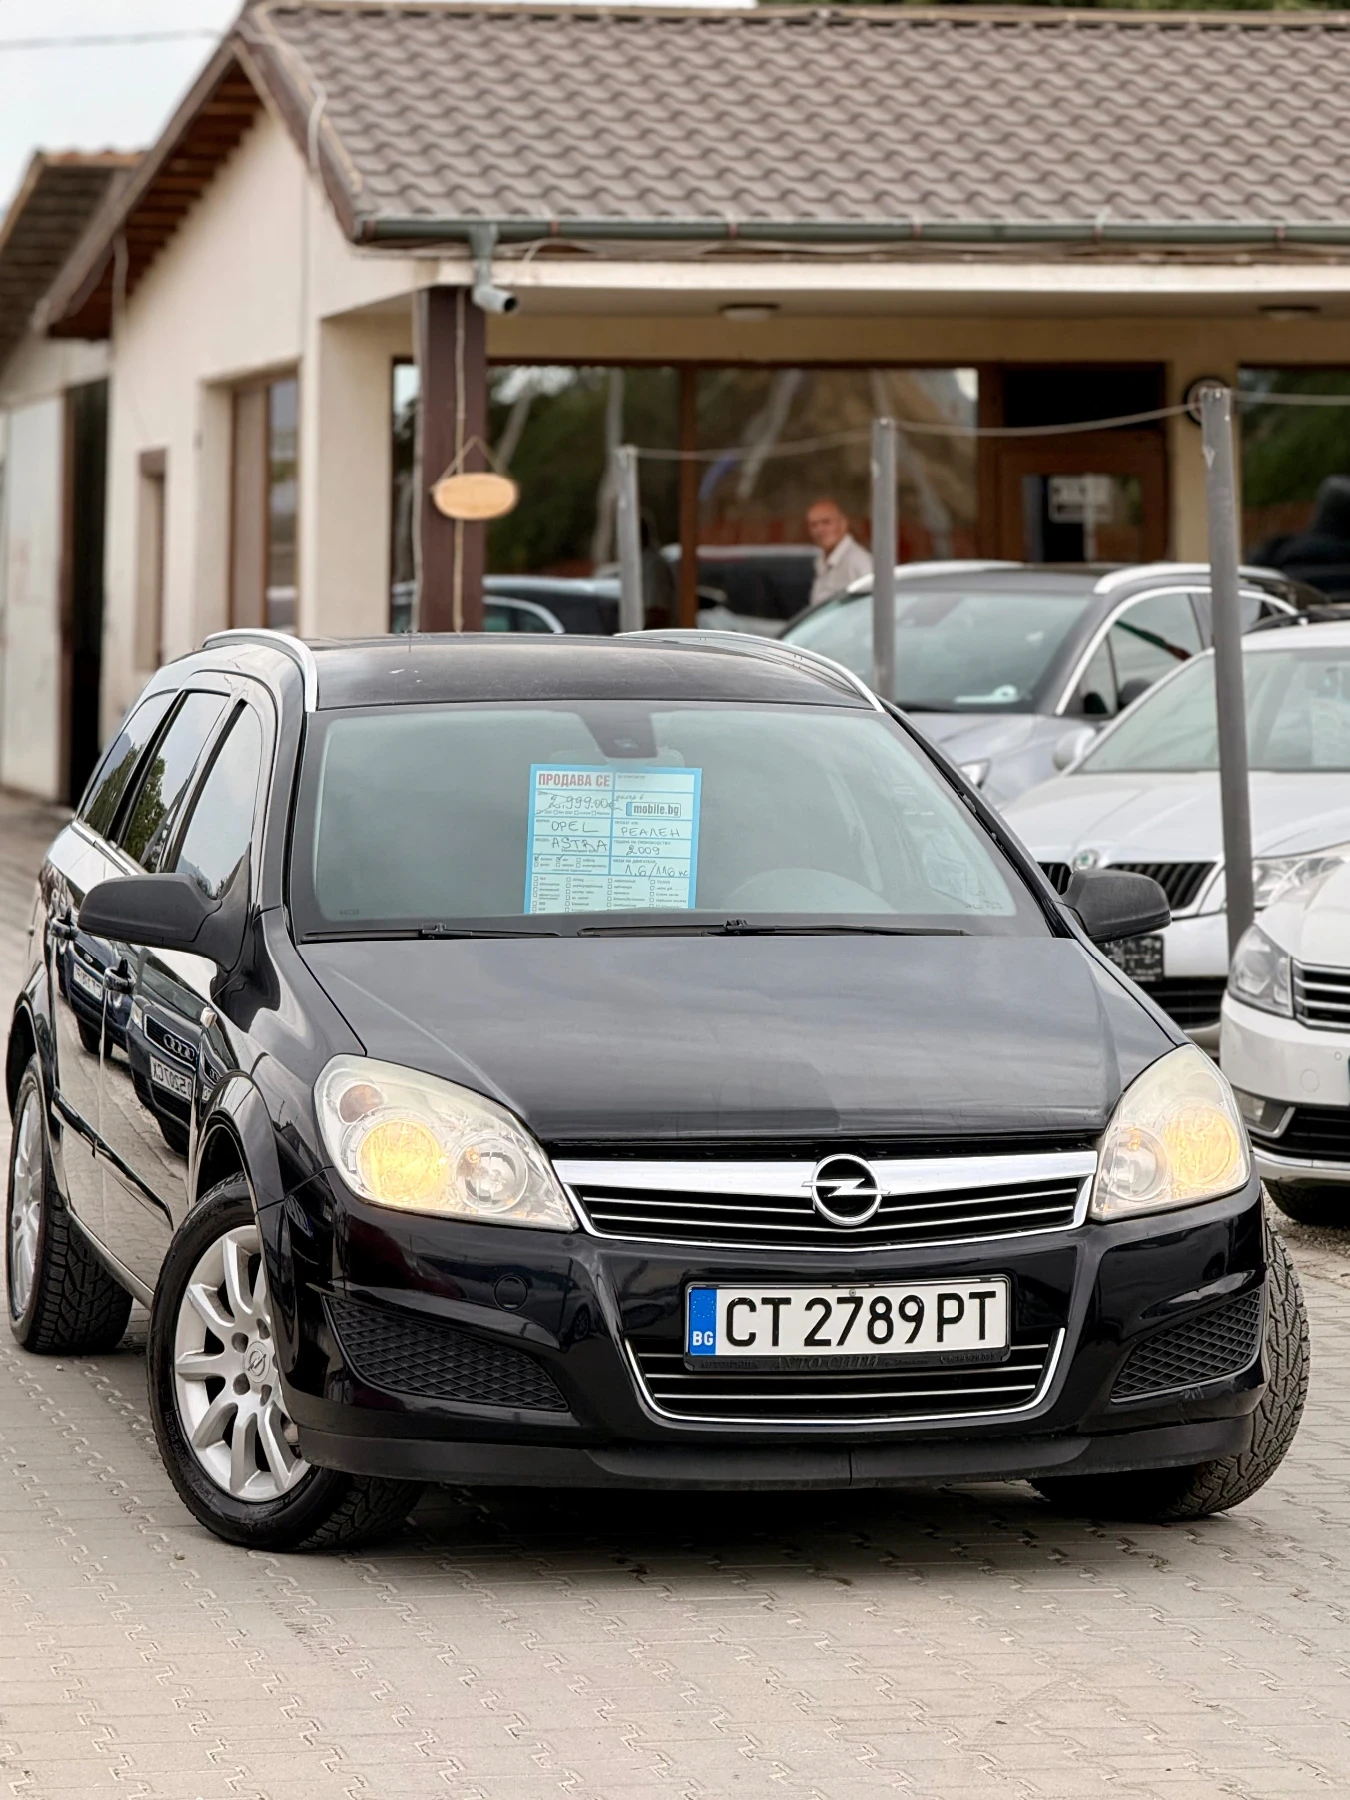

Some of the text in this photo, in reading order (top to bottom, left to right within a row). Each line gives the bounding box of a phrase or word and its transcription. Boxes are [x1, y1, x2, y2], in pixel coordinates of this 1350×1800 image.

[538, 773, 611, 788] ПРОДАВА СЕ
[633, 804, 679, 816] mobile.bg
[551, 820, 599, 833] OPEL
[621, 826, 681, 838] РЕАЛЕН
[551, 836, 608, 852] ASTRA
[625, 844, 660, 856] 2009
[725, 1290, 997, 1347] CT 2789 PT
[692, 1331, 714, 1346] BG
